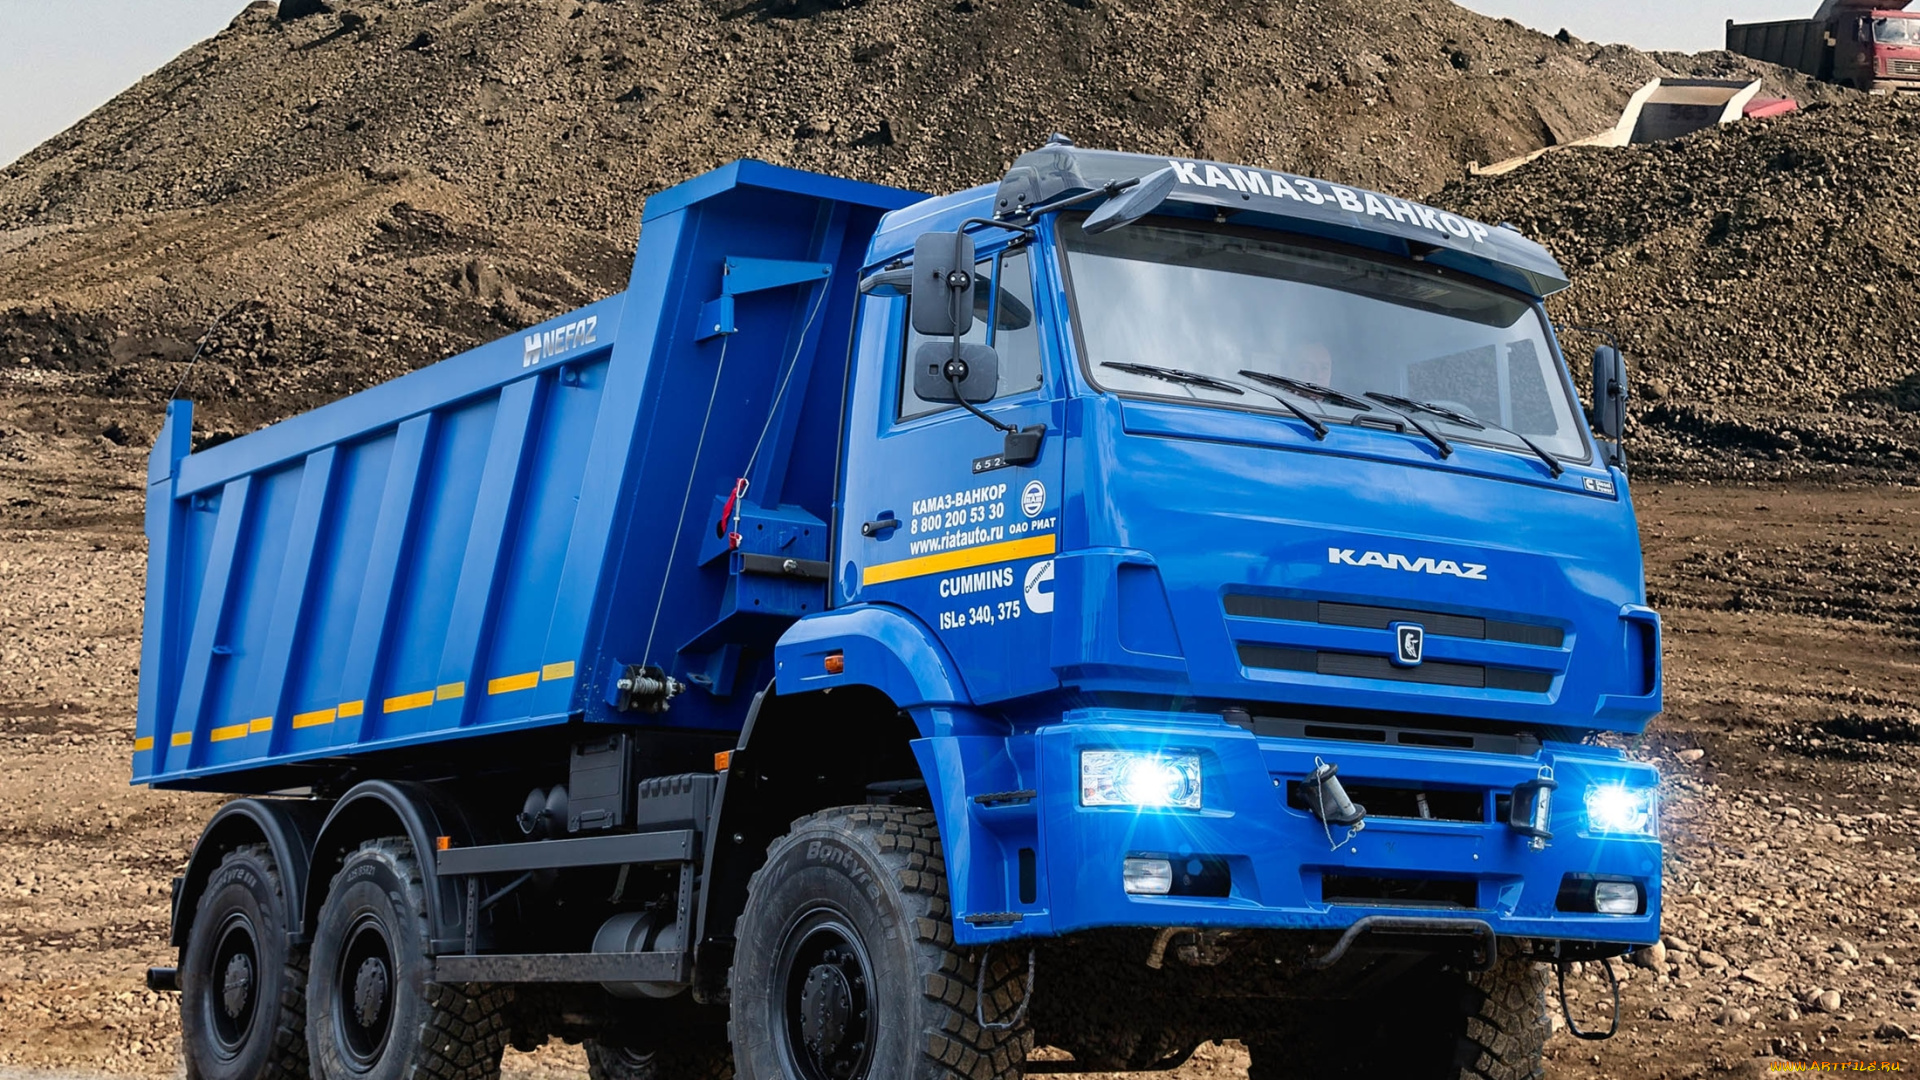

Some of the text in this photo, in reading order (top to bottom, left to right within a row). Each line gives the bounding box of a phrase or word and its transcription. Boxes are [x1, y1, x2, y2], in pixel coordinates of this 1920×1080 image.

[1168, 159, 1489, 244] КАМАЗ-ВАНКОР
[542, 315, 597, 359] NEFAZ
[975, 457, 1006, 470] 652
[912, 483, 1007, 516] КАМАЗ-ВАНКОР
[910, 502, 1004, 535] 8 800 200 53 30
[1009, 517, 1056, 534] ОАО РИАТ
[910, 526, 1004, 556] www.riatauto.ru
[1025, 561, 1051, 594] Cummins
[1328, 547, 1488, 581] KAMAZ
[939, 567, 1013, 598] CUMMINS
[940, 600, 1021, 630] ISLe 340, 375
[806, 840, 882, 900] Bontyre
